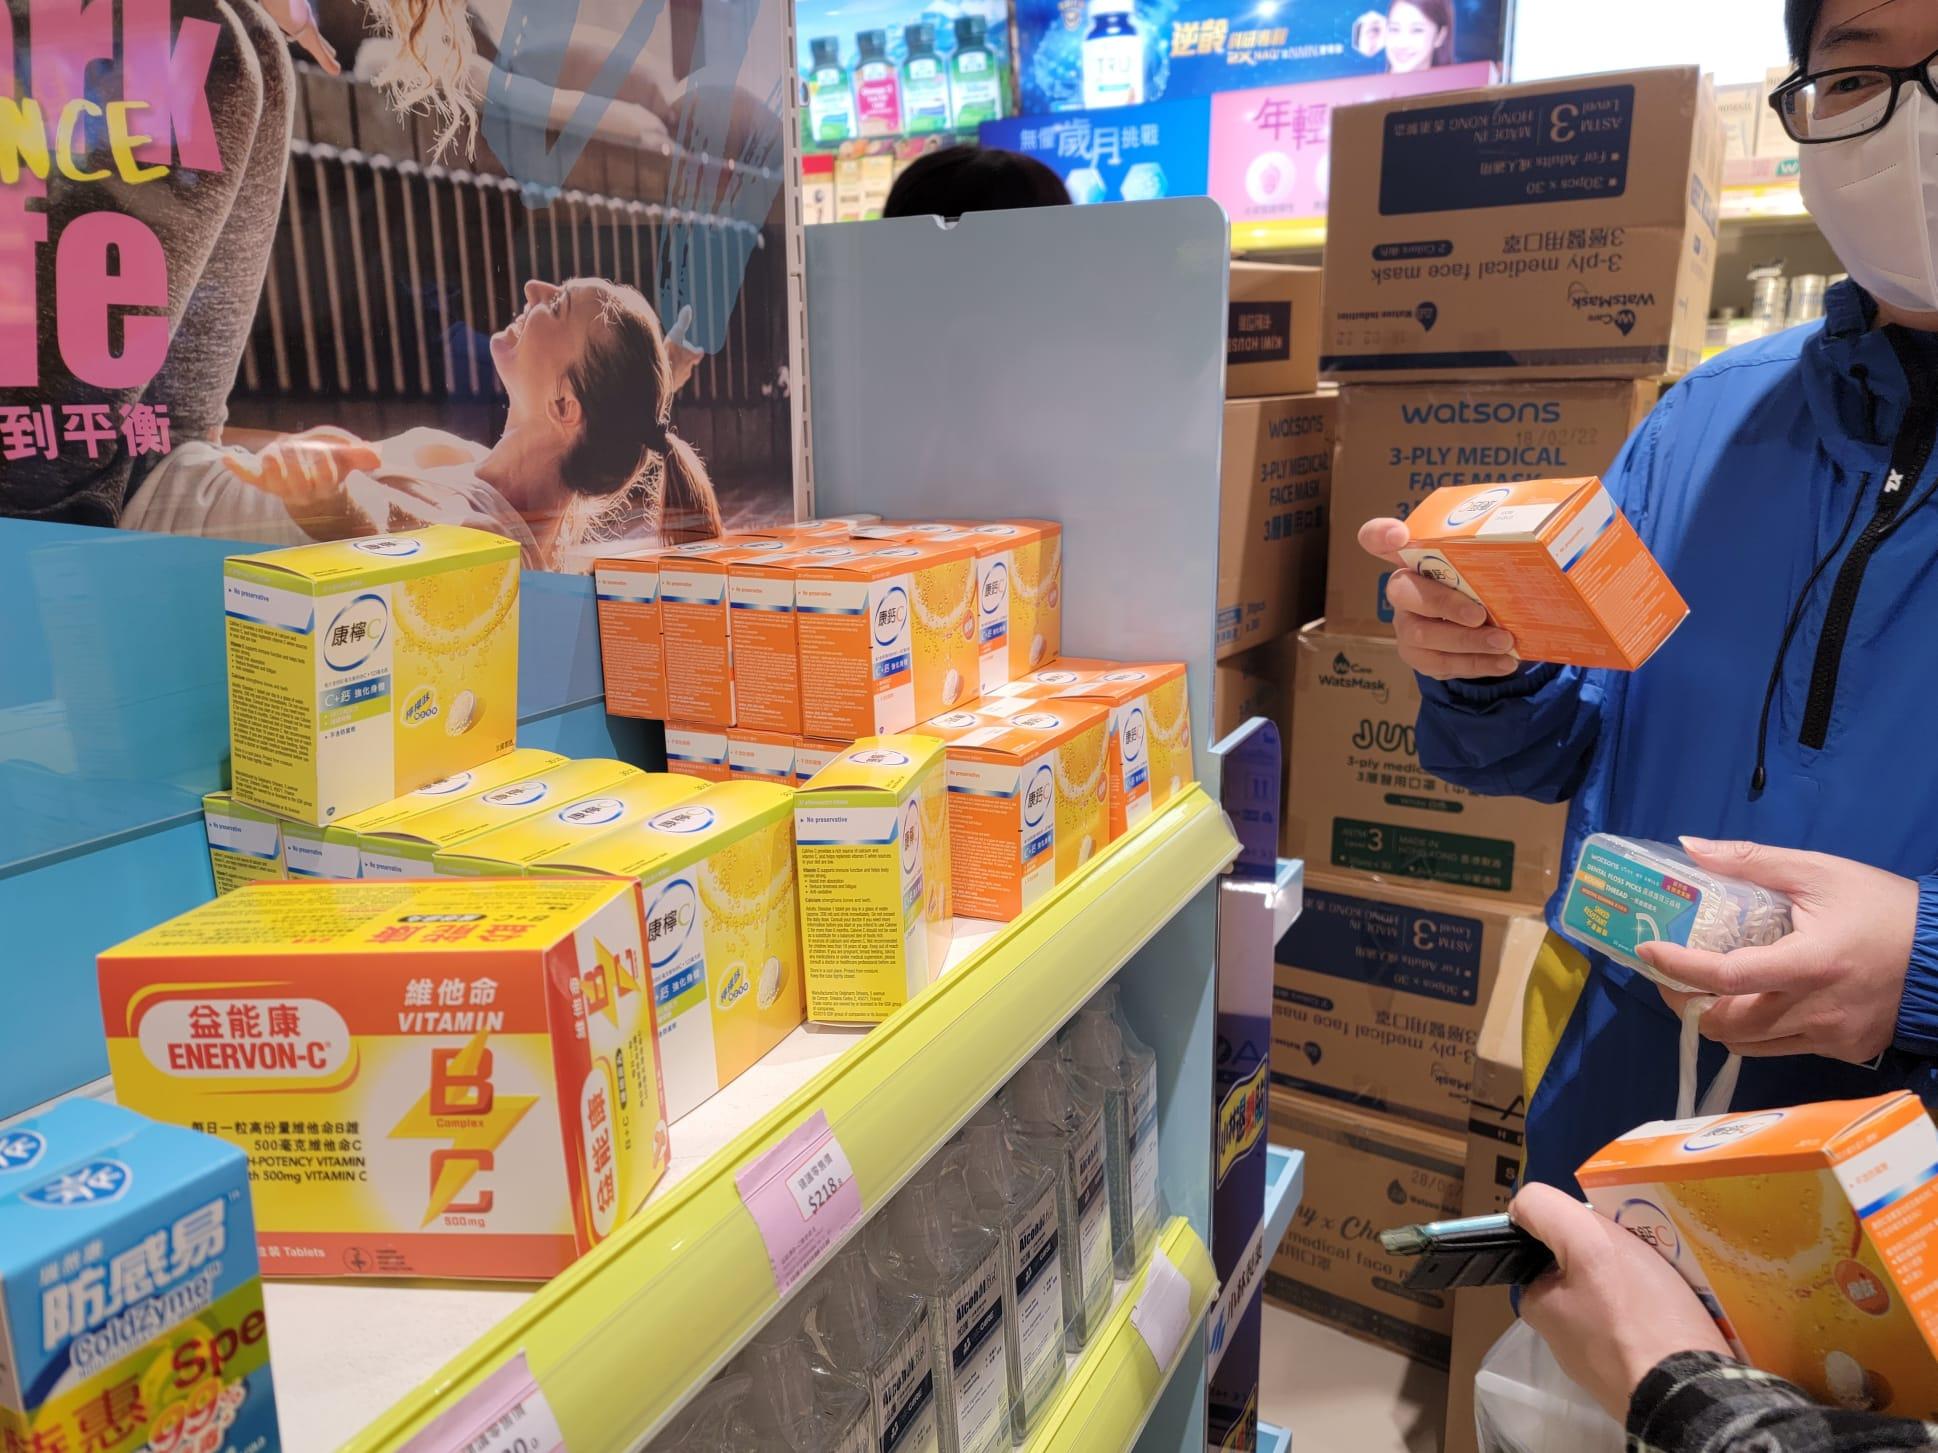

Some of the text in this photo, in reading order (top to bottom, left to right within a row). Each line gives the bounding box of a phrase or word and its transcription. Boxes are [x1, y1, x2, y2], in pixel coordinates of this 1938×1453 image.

[0, 0, 224, 172] rk
[1254, 97, 1329, 150] 年輕
[1549, 103, 1580, 143] 3
[1560, 174, 1604, 191] 30pcs
[1370, 252, 1623, 286] 3-ply medical face mask
[1571, 292, 1655, 309] WatsMask
[1401, 401, 1562, 425] watsons
[2, 403, 171, 461] 到平衡
[1268, 415, 1325, 440] watsons
[1389, 447, 1567, 466] 3-PLY MEDICAL
[1261, 458, 1288, 483] 3-PLY
[1408, 472, 1465, 491] FACE
[1268, 480, 1321, 505] FACE MASK
[878, 604, 905, 627] 康鈣C
[331, 616, 383, 648] 康檸C
[1383, 760, 1423, 774] medic
[806, 816, 848, 826] No preservative
[1412, 918, 1437, 950] 3
[404, 978, 498, 1007] 維他命
[188, 1003, 302, 1040] 益能康
[398, 1012, 505, 1033] VITAMIN
[167, 1041, 328, 1072] ENERVON-C
[430, 1048, 494, 1116] B
[435, 1117, 485, 1131] Complex
[254, 1139, 362, 1152] 500毫克維他命C
[316, 1156, 366, 1168] VITAMIN
[262, 1170, 301, 1184] 500mg
[304, 1171, 356, 1181] VITAMIN
[358, 1171, 368, 1181] C
[444, 1215, 487, 1229] 500mg
[284, 1247, 327, 1258] Tablets
[42, 1198, 227, 1352] 防感易
